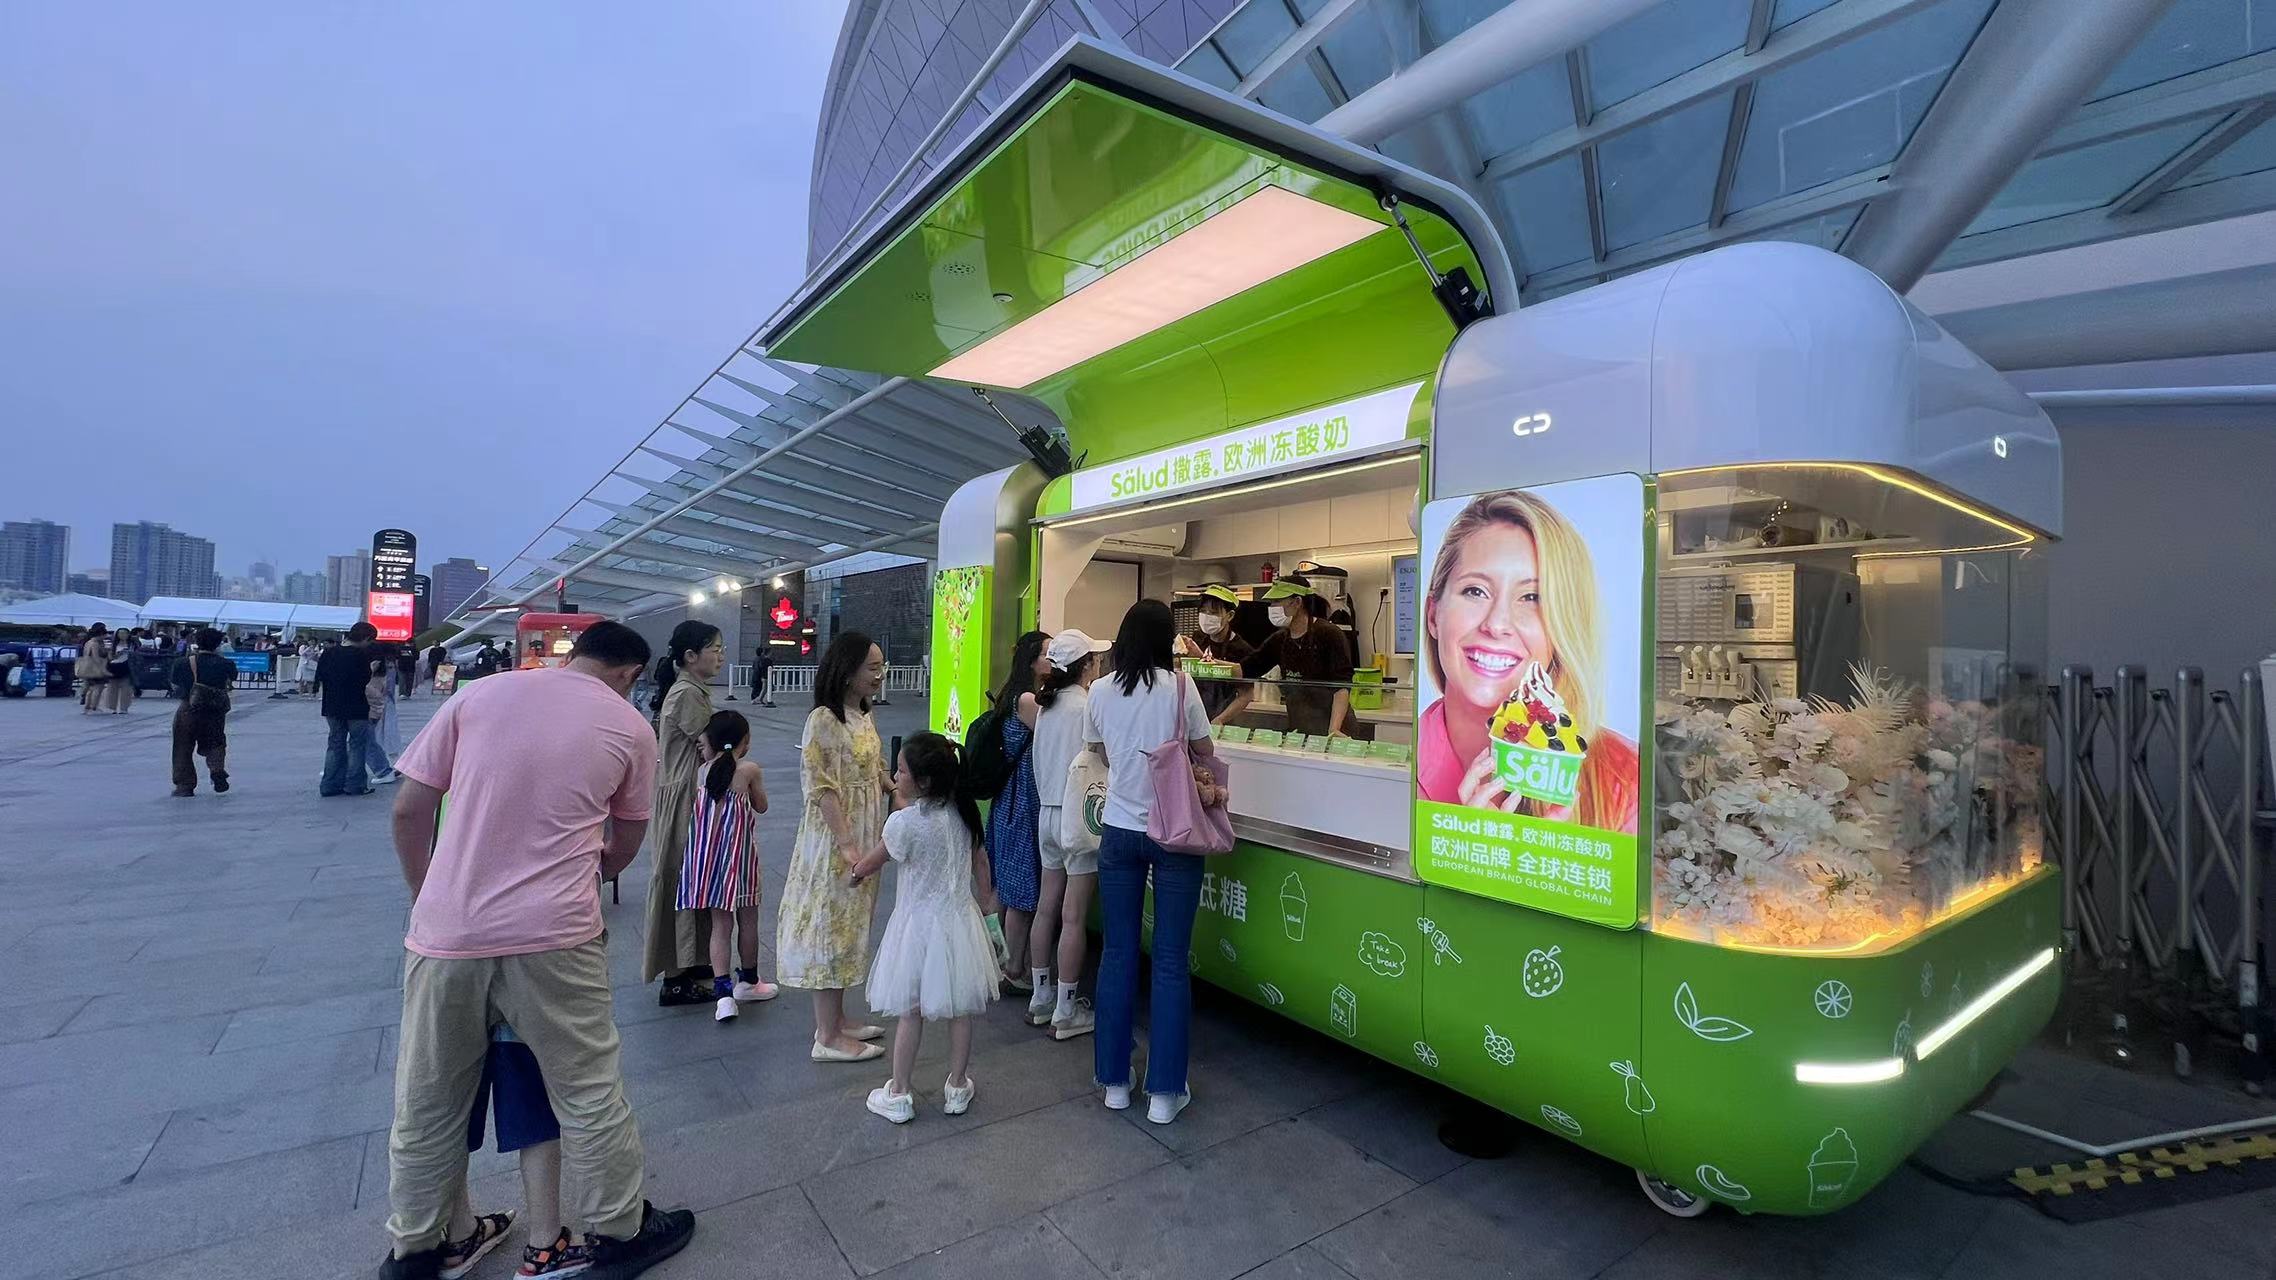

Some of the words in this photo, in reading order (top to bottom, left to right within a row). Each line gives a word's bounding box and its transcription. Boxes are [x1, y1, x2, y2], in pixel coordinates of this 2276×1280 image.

[1110, 460, 1168, 497] Sälud
[1431, 813, 1480, 835] Sälud
[1431, 836, 1511, 869] 欧洲品牌
[1516, 851, 1612, 893] 全球连锁
[1431, 859, 1485, 876] EUROPEAN
[1486, 869, 1523, 884] BRAND
[1525, 878, 1571, 896] GLOBAL
[1573, 889, 1612, 906] CHAIN
[1369, 940, 1391, 954] Take
[1376, 953, 1399, 969] break
